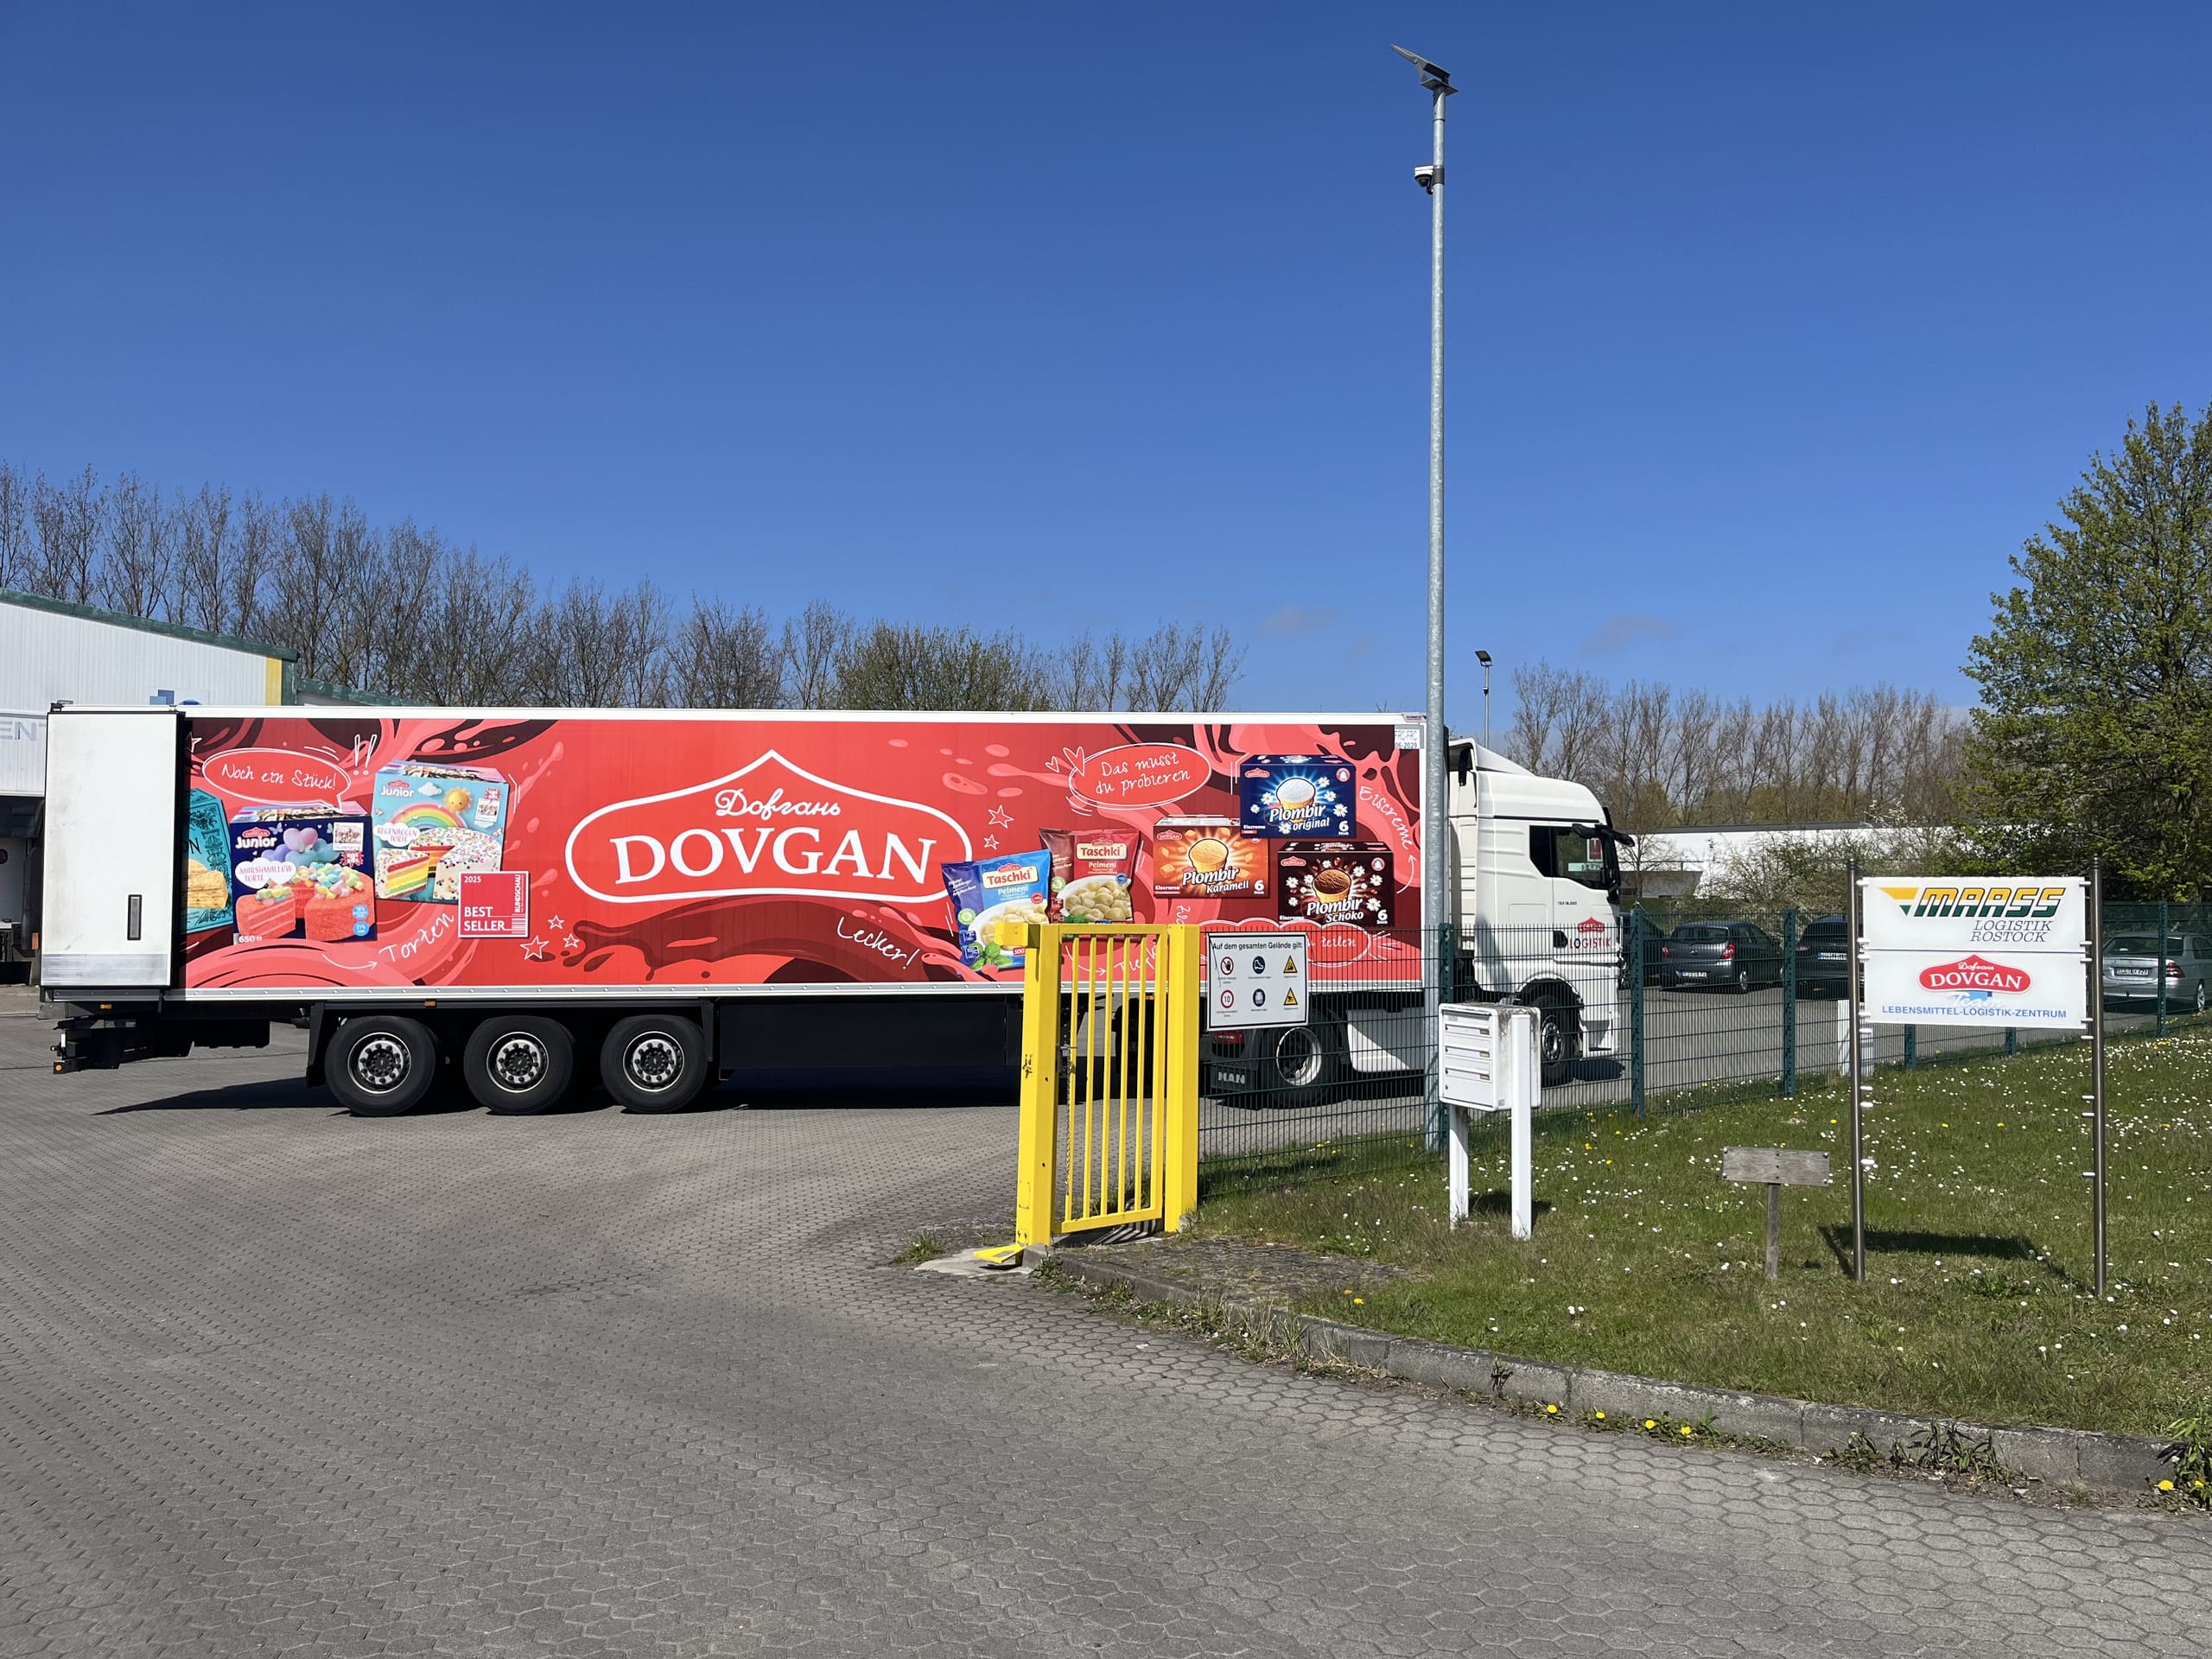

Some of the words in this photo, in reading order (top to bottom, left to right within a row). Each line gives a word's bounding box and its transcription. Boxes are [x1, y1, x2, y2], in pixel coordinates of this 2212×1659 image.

[1101, 761, 1128, 777] Das
[1135, 751, 1179, 770] musst
[221, 763, 255, 780] Noch
[261, 772, 284, 784] ein
[291, 769, 337, 791] Stück!
[1095, 780, 1115, 795] du
[1120, 770, 1191, 797] probieren
[380, 785, 415, 798] Junior
[1269, 802, 1326, 822] Plombir
[1358, 785, 1414, 850] Eiscreme
[1292, 817, 1330, 830] original
[1338, 820, 1349, 832] 6
[377, 826, 417, 837] REGENBOGEN
[235, 836, 277, 849] Junior
[609, 827, 937, 884] DOVGAN
[1080, 847, 1121, 856] Taschki
[238, 865, 293, 874] MARSHMALLOW
[1182, 866, 1240, 886] Plombir
[987, 869, 1031, 886] Taschki
[997, 885, 1028, 895] Pelmeni
[1205, 880, 1249, 894] Karamell
[1254, 880, 1265, 891] 6
[1306, 897, 1363, 916] Plombir
[1914, 887, 2067, 918] MAASS
[463, 906, 493, 918] BEST
[1325, 911, 1364, 923] Schoko
[1377, 909, 1388, 920] 6
[463, 920, 505, 931] SELLER
[1973, 920, 2053, 931] LOGISTIK
[378, 912, 454, 963] Torten
[836, 916, 920, 969] Lecker!
[1969, 931, 2047, 943] ROSTOCK
[1238, 942, 1267, 950] gesamten
[1569, 938, 1611, 950] LOGISTIK
[1929, 972, 2023, 989] DOVGAN
[1882, 1005, 2067, 1018] LEBENSMITTEL-LOGISTIK-ZENTRUM
